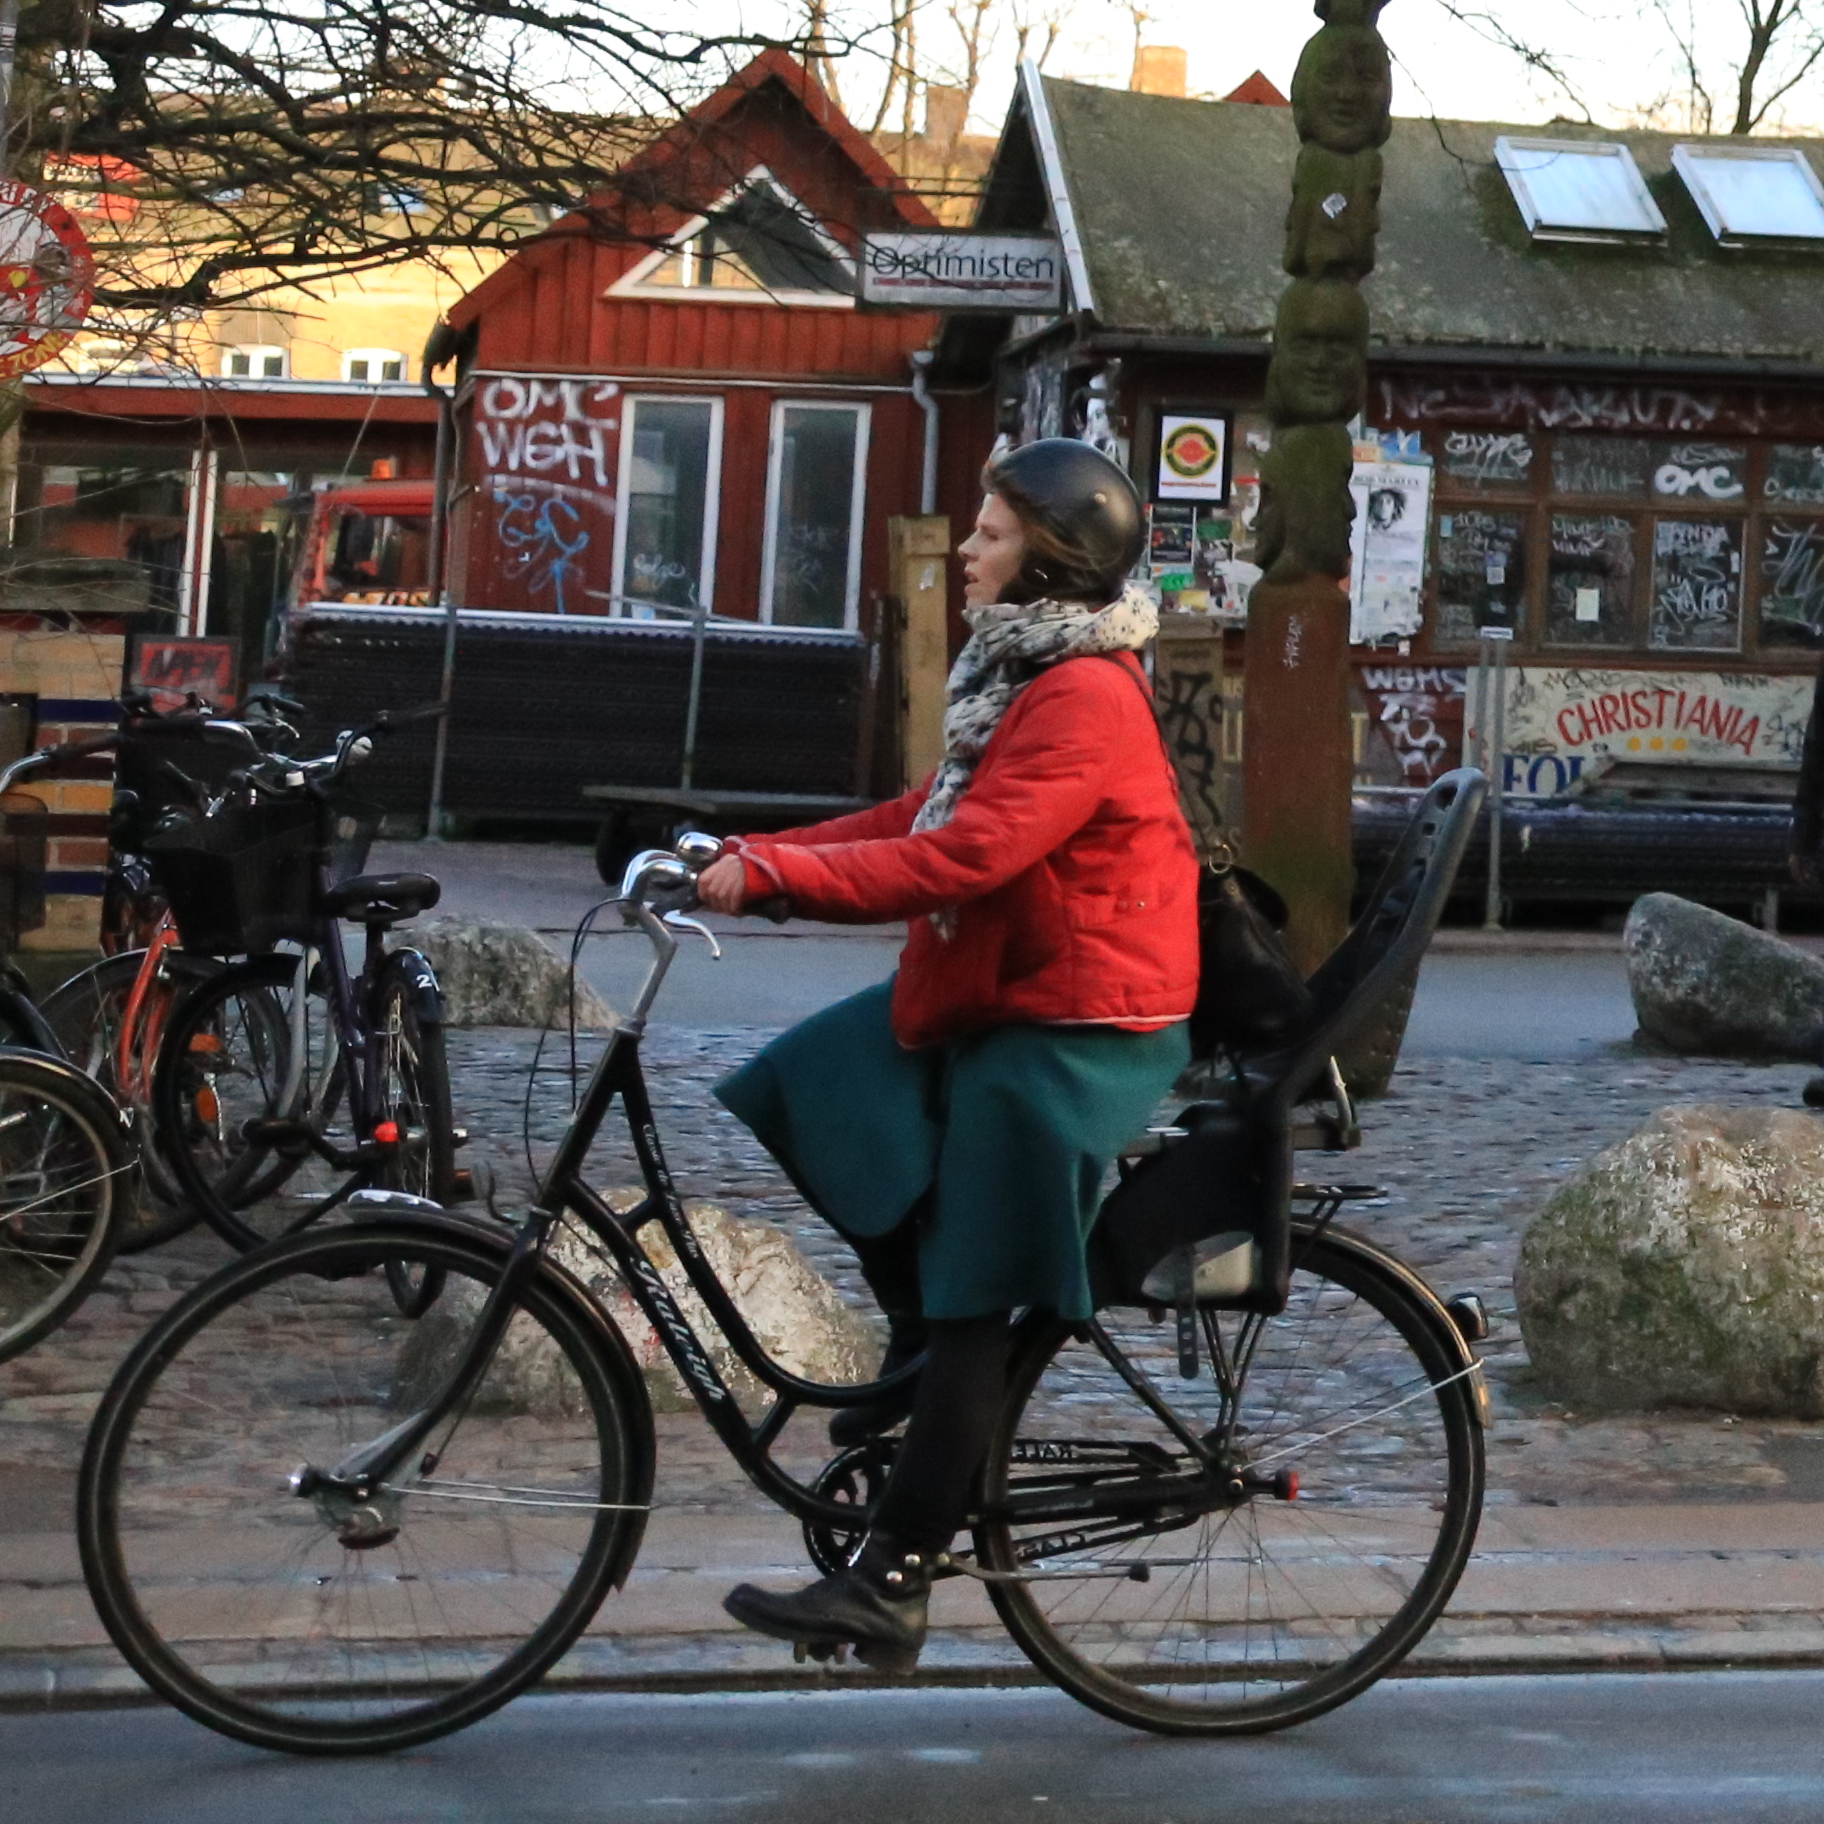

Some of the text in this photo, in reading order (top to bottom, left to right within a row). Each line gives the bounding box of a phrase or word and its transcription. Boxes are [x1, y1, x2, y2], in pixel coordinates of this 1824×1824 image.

[873, 247, 1054, 278] Optimisten
[1555, 688, 1761, 756] CHRISTIANIA
[643, 1123, 661, 1163] Classic
[682, 1229, 699, 1259] Plus
[629, 1256, 726, 1402] Raleigh
